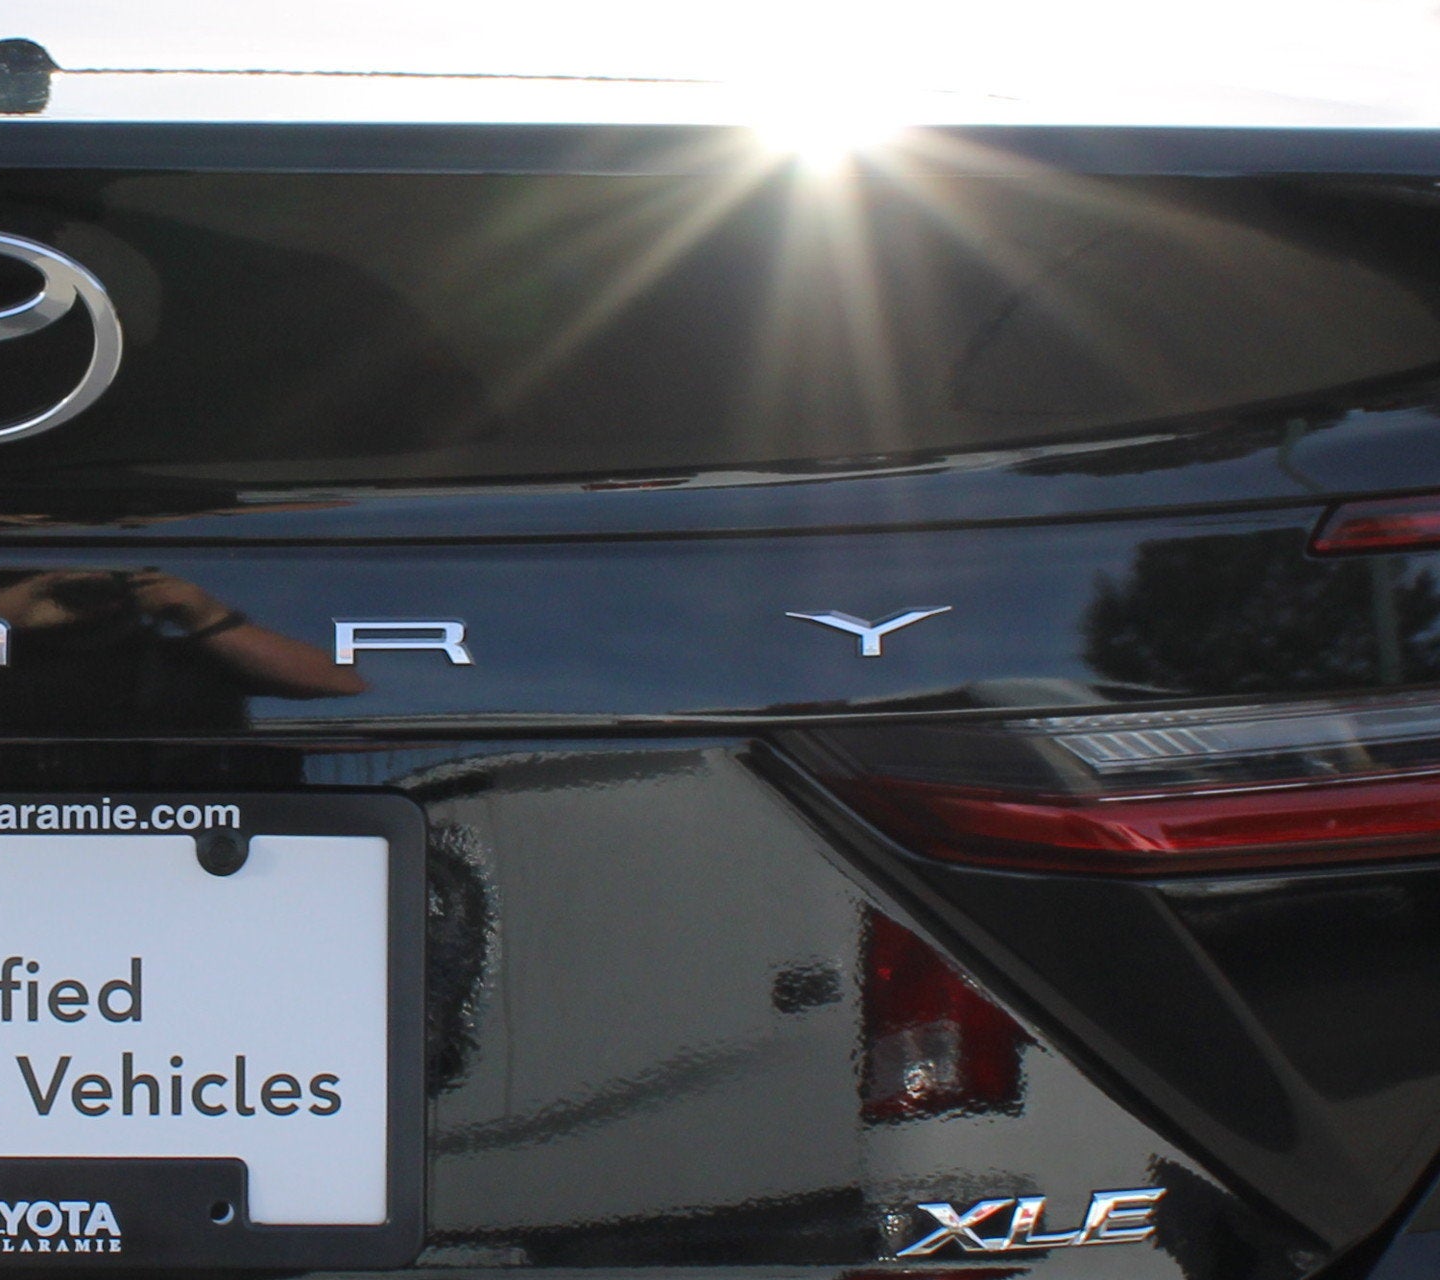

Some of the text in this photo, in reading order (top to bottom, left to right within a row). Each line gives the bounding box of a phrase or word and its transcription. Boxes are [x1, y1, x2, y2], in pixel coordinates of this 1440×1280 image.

[15, 1052, 342, 1118] Vehicles
[2, 1238, 122, 1253] LARAMIE
[896, 1187, 1168, 1258] XLE
